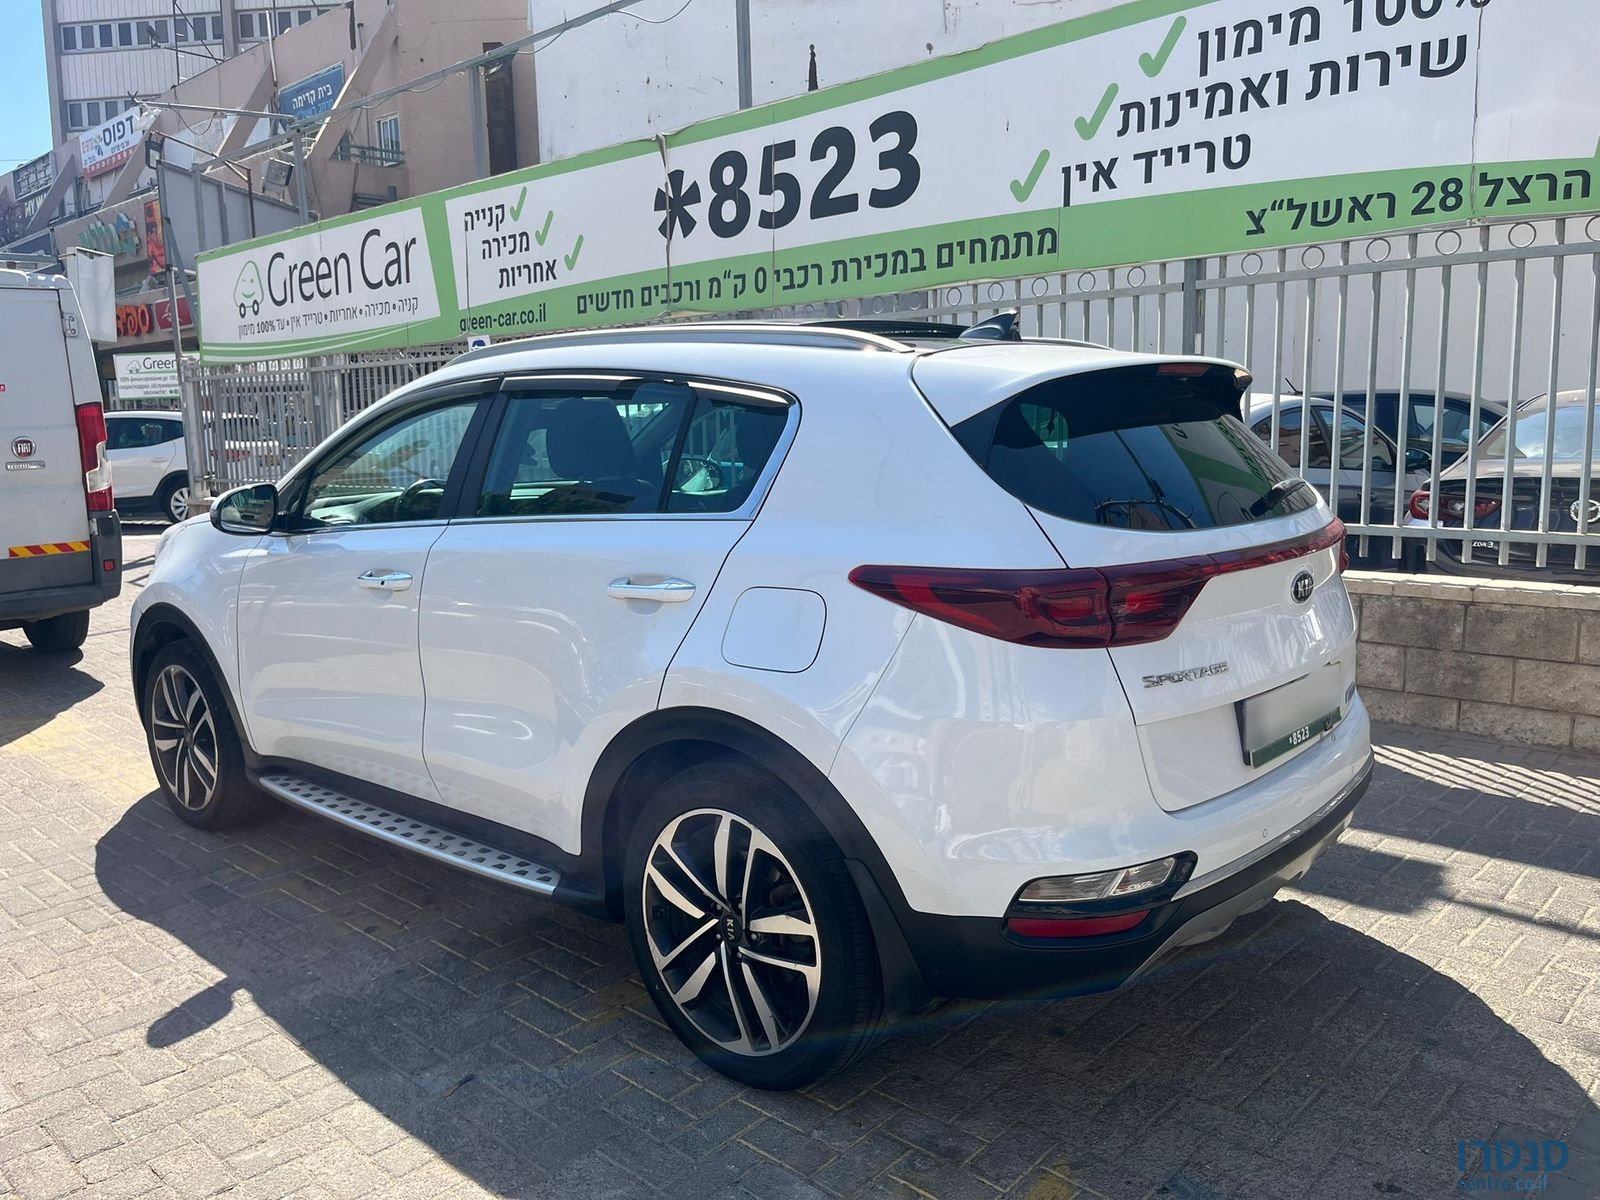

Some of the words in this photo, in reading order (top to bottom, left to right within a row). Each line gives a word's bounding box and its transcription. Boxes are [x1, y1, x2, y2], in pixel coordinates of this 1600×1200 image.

[1343, 0, 1490, 33] 100
[1197, 6, 1322, 77] מימון
[1305, 34, 1468, 102] שירות
[317, 84, 333, 99] בית
[1116, 70, 1288, 138] ואמינות
[102, 115, 134, 146] דפוס
[1133, 133, 1252, 185] טרייד
[1062, 155, 1118, 207] אין
[1479, 169, 1591, 208] הרצל
[1411, 178, 1464, 216] 28
[464, 203, 505, 232] קנייה
[482, 231, 530, 260] מכירה
[936, 226, 1059, 269] מתמחים
[267, 251, 352, 307] Green
[360, 228, 417, 290] Car
[498, 259, 558, 289] אחריות
[774, 262, 824, 291] רכבי
[831, 246, 927, 284] במכירת
[640, 279, 701, 308] ורכבים
[753, 266, 768, 295] 0
[329, 305, 358, 323] אחריות
[364, 301, 391, 317] מכירה
[398, 296, 419, 316] קניה
[577, 287, 635, 316] חדשים
[256, 319, 276, 334] 100%
[302, 311, 323, 326] טרייד
[459, 302, 547, 333] green-car.co.il
[17, 443, 31, 453] FIAT
[1142, 661, 1230, 689] SPORTAGE
[726, 918, 735, 940] KIA
